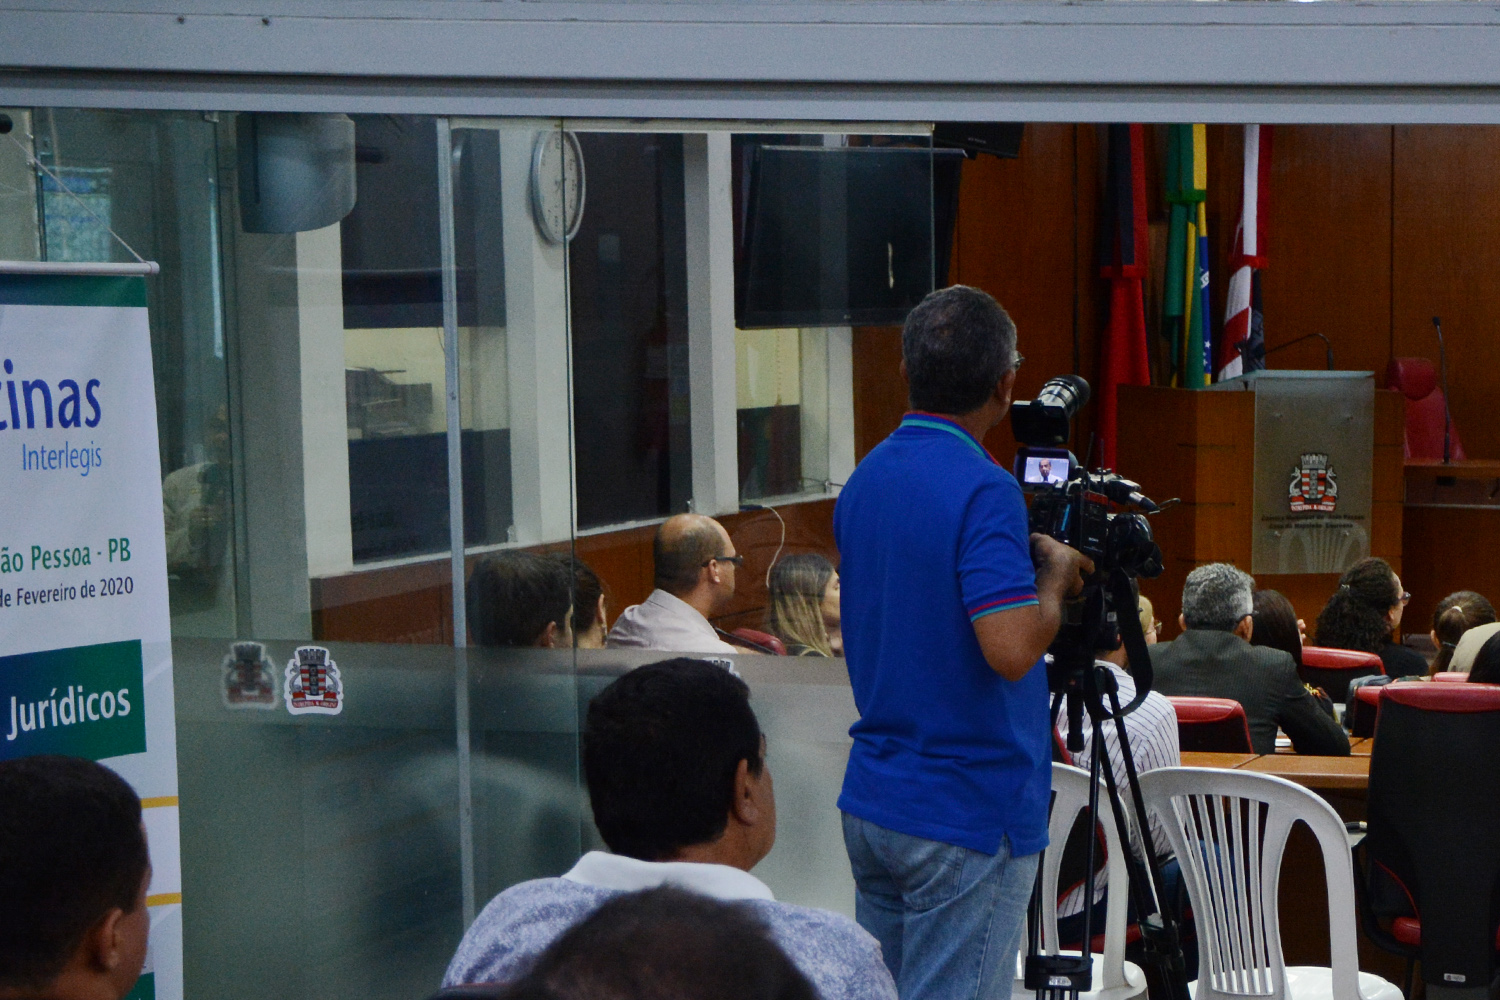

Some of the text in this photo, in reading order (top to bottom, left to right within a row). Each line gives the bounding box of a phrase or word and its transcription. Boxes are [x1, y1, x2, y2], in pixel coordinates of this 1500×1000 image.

[22, 441, 102, 477] Interlegis
[31, 544, 92, 571] Pessoa
[108, 537, 131, 564] PB
[16, 582, 76, 606] Fevereiro
[80, 580, 96, 600] de
[100, 576, 134, 598] 2020
[6, 685, 132, 741] Jurídicos
